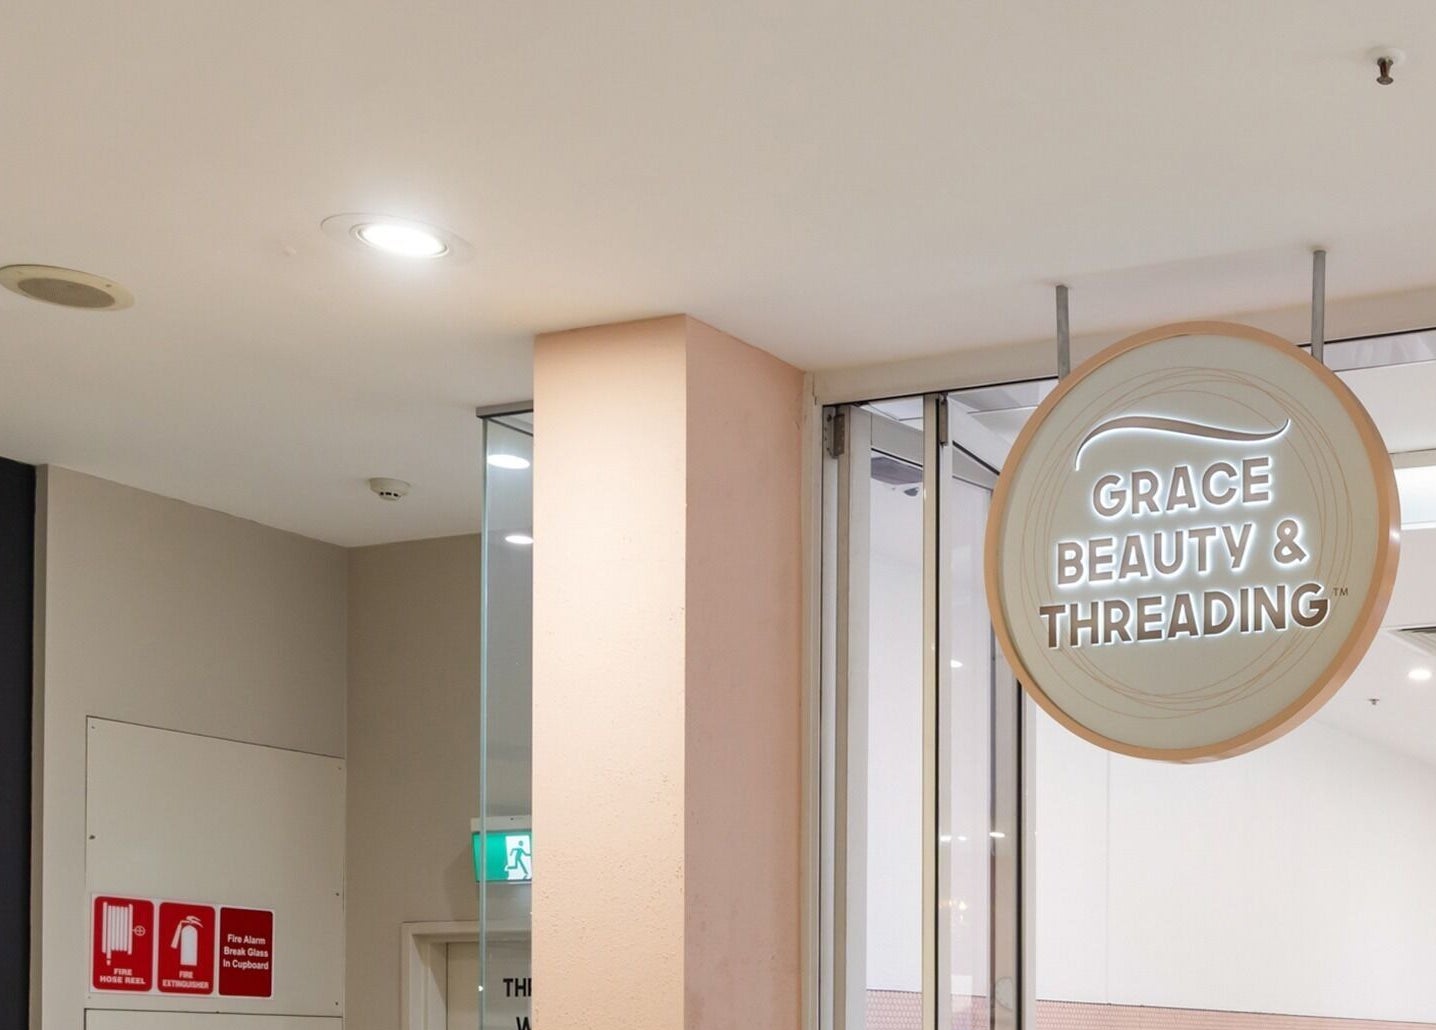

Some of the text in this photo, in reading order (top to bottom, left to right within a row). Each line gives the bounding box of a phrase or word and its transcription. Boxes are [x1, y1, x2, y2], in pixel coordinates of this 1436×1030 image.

[1091, 456, 1272, 518] GRACE
[1056, 519, 1307, 586] BEAUTY &
[1039, 583, 1330, 650] THREADING
[227, 933, 266, 945] Fire Alarm
[223, 946, 269, 958] Break Glass
[113, 967, 133, 977] FIRE
[223, 960, 270, 972] In Cupboard
[99, 975, 147, 985] HOSE REEL
[179, 970, 194, 979] FIRE
[162, 979, 210, 989] EXTINGUISHER
